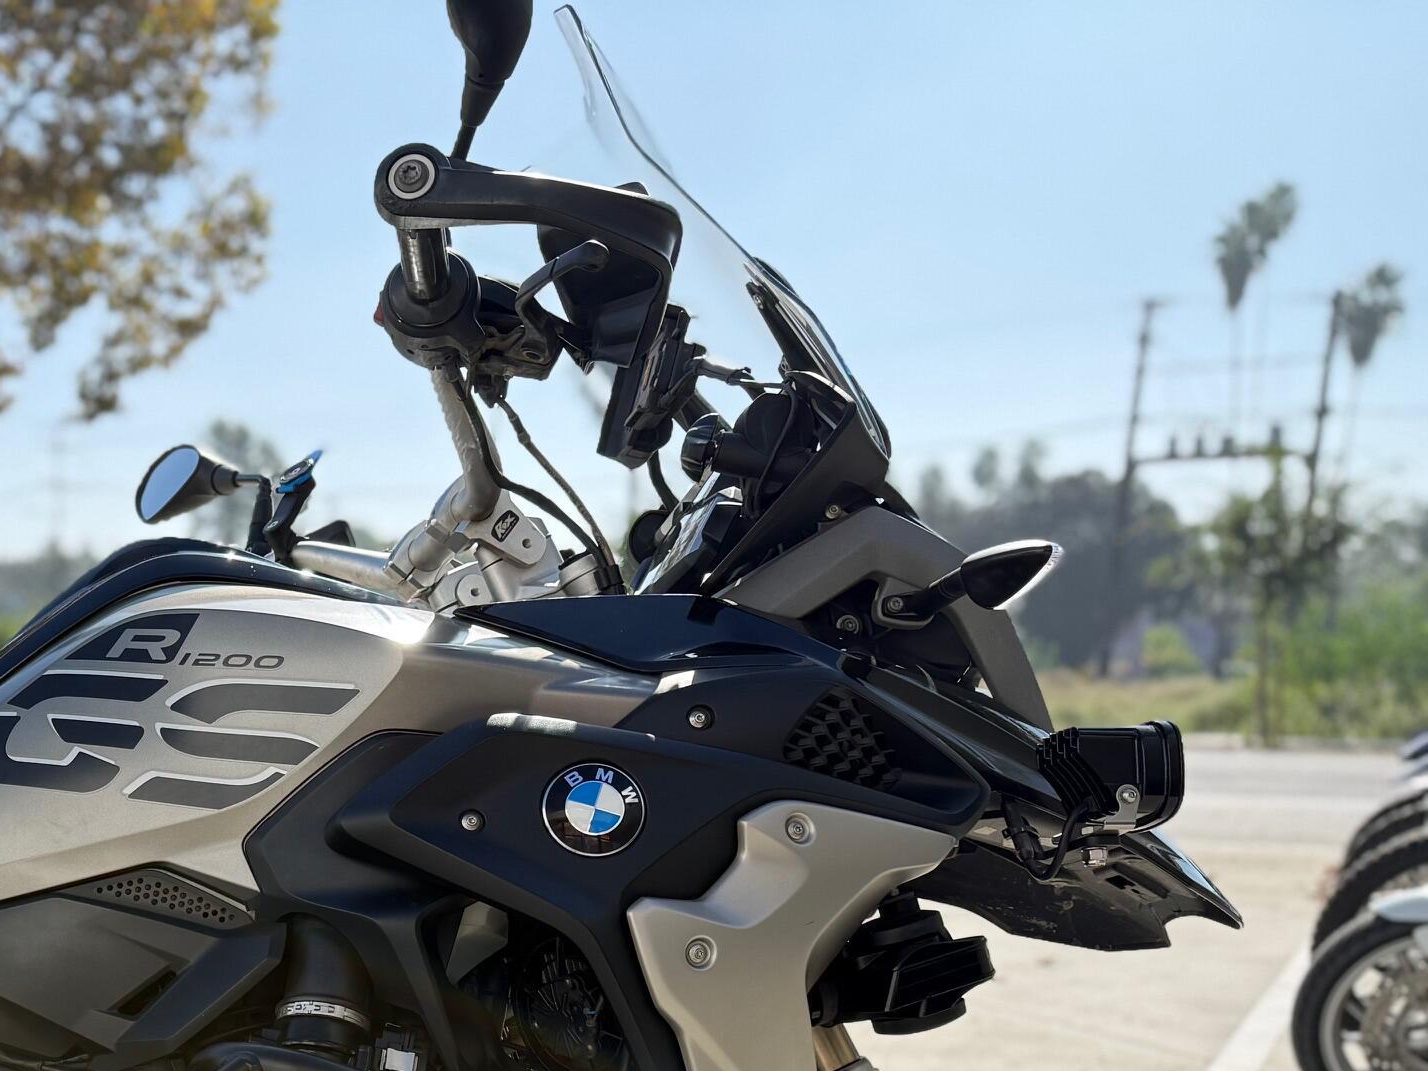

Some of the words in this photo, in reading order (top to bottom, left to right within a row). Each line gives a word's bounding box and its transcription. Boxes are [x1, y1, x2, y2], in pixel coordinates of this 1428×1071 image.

[105, 628, 182, 660] R
[178, 652, 284, 670] 1200
[564, 768, 639, 803] BMW
